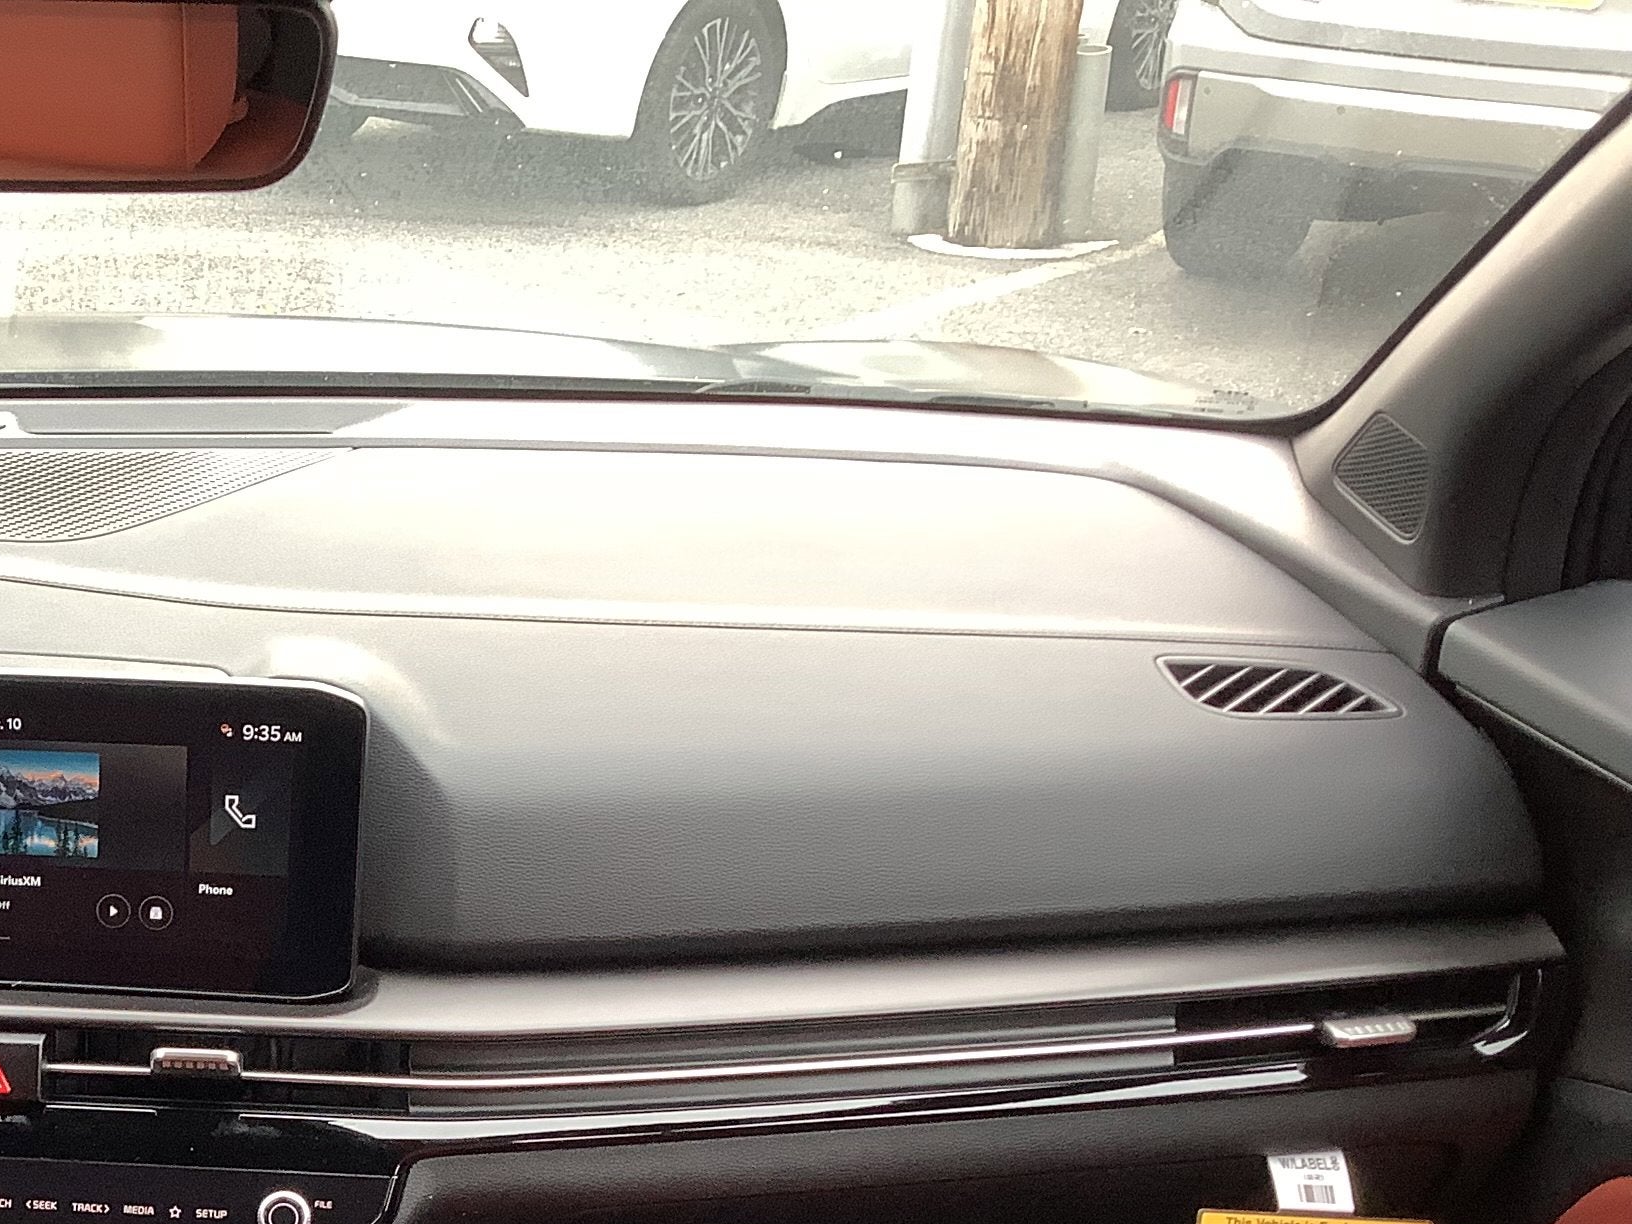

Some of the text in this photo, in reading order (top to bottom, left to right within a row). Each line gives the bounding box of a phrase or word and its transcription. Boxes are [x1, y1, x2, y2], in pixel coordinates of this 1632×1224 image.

[6, 718, 22, 730] 10
[242, 725, 302, 742] 9:35 AM
[198, 883, 233, 896] Phone
[315, 1200, 333, 1209] FILE
[123, 1205, 155, 1216] MEDIA
[195, 1208, 228, 1219] SETUP
